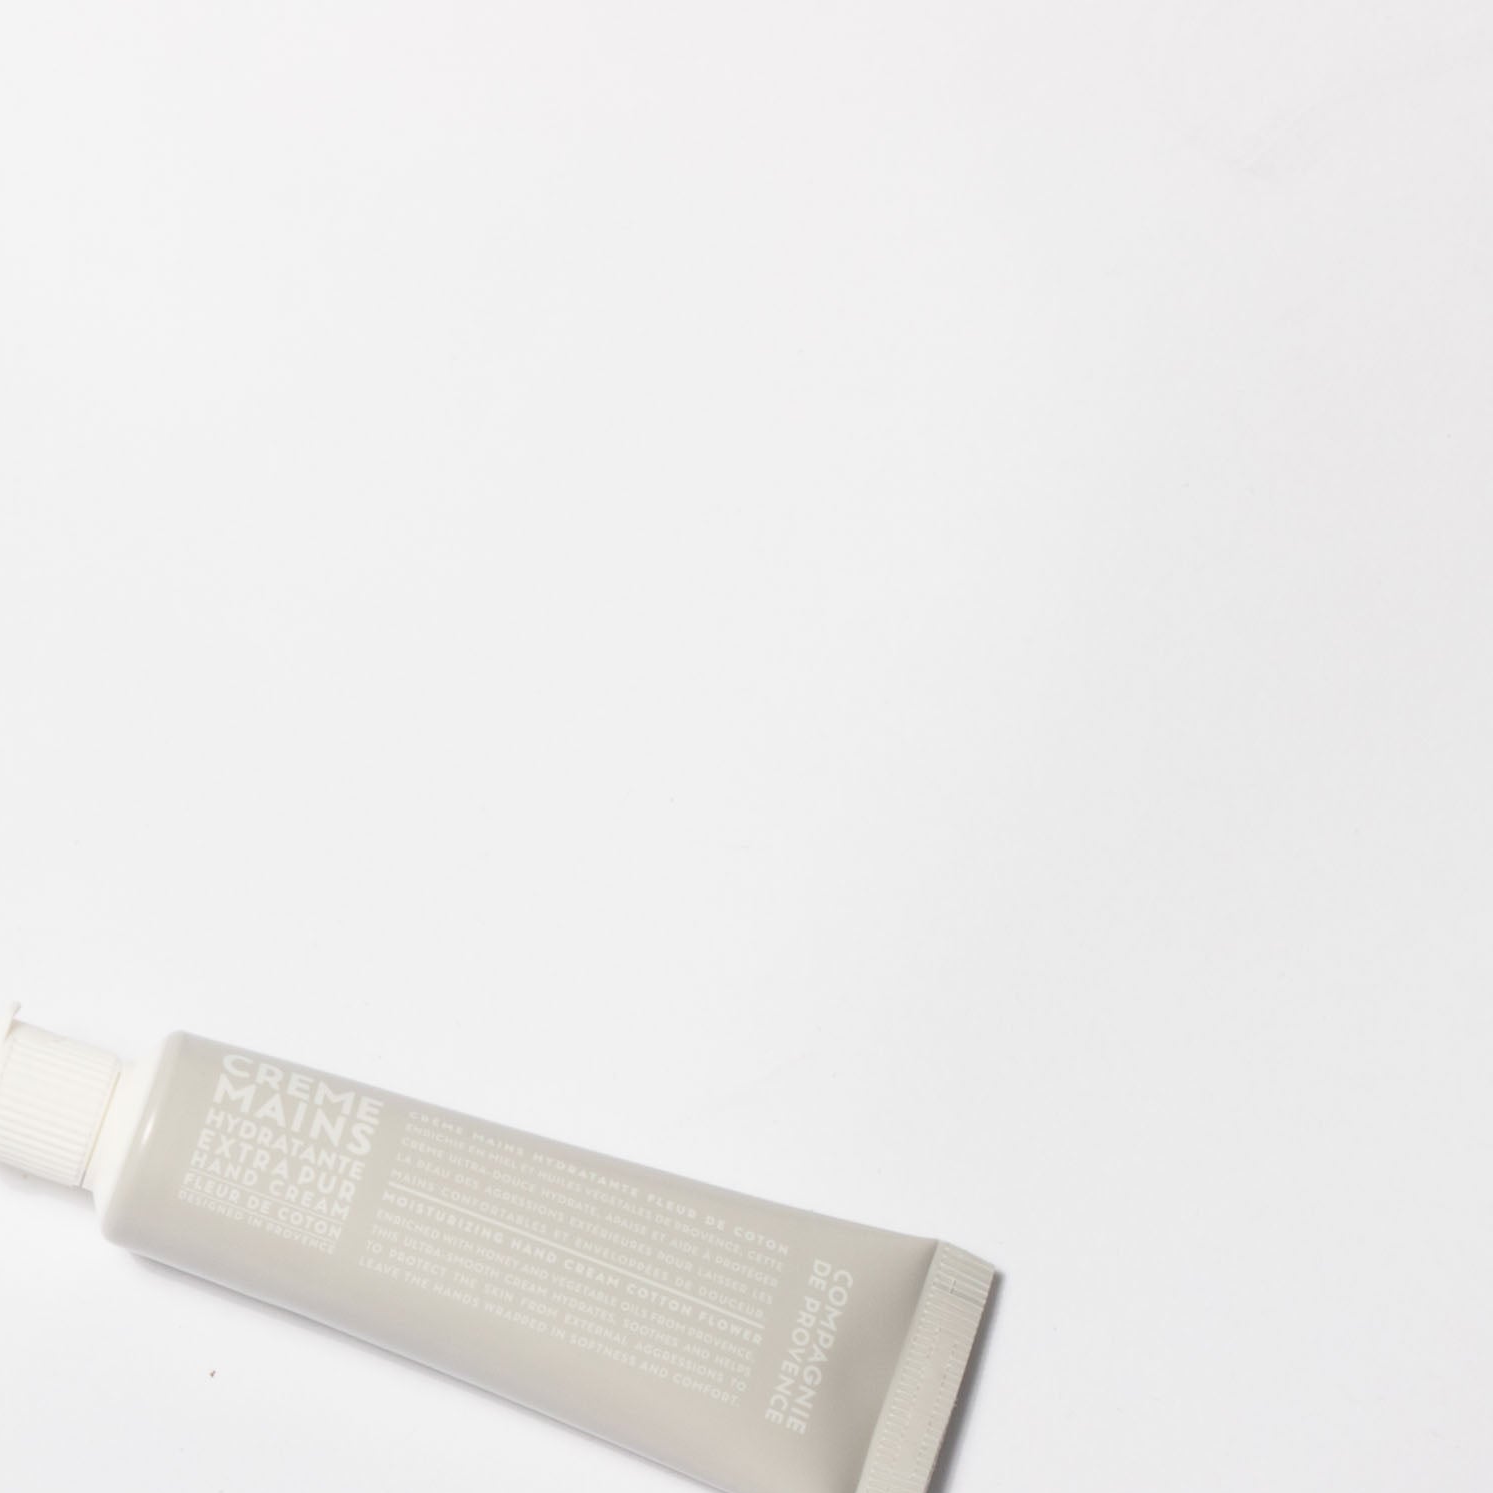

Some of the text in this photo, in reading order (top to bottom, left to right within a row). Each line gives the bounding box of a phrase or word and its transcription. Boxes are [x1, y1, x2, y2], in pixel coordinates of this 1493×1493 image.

[212, 1073, 375, 1156] MAINS
[222, 1053, 384, 1126] CREME
[196, 1127, 356, 1203] EXTRA PUR
[204, 1106, 366, 1182] HYDRATANTE
[182, 1171, 343, 1241] FLEUR DE COTON
[189, 1149, 351, 1221] HAND CREAM
[247, 1215, 264, 1228] IN
[265, 1221, 337, 1256] PROVENCE
[381, 1189, 504, 1244] MOISTURIZING
[510, 1238, 558, 1264] HAND
[563, 1258, 621, 1289] CREAM
[625, 1282, 693, 1317] COTTON
[697, 1310, 763, 1345] FLOWER
[732, 1225, 790, 1256] COTON
[807, 1258, 832, 1292] DE
[358, 1255, 401, 1280] LEAVE
[404, 1270, 431, 1290] THE
[432, 1282, 480, 1308] HANDS
[638, 1360, 669, 1379] AND
[784, 1268, 855, 1435] COMPAGNIE
[763, 1295, 822, 1425] PROVENCE
